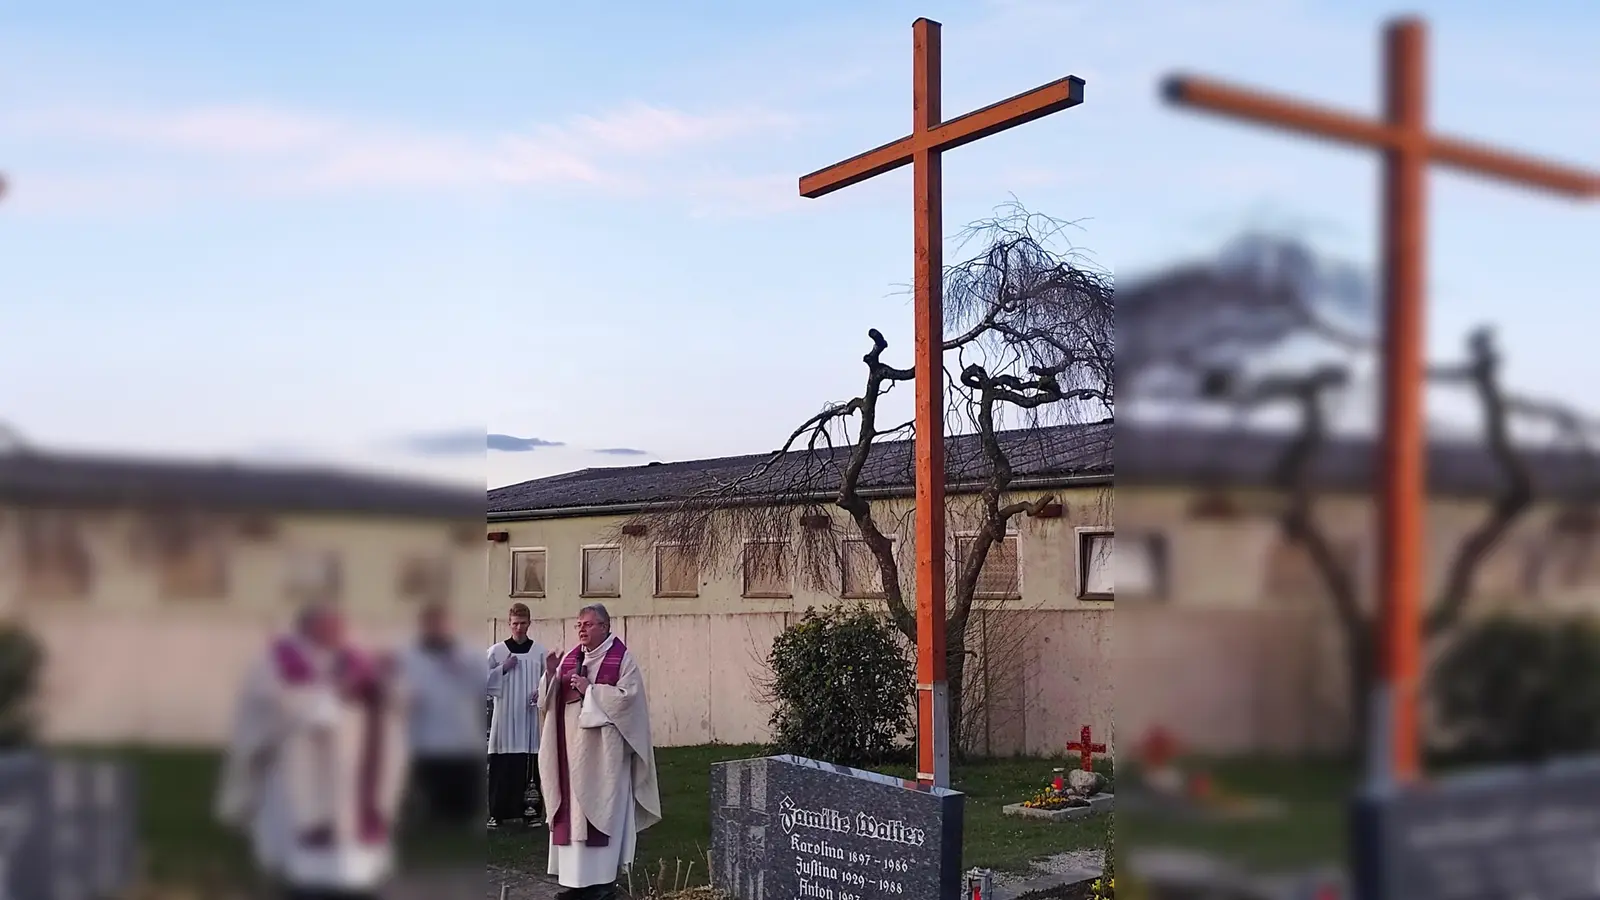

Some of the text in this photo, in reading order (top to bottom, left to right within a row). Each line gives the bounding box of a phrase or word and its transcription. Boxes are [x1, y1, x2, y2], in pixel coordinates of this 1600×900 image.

[779, 795, 925, 846] Familie Walter
[790, 833, 844, 860] Karolina
[849, 852, 871, 866] 1897
[884, 859, 908, 873] 1986
[799, 878, 833, 900] Anton
[842, 871, 865, 889] 1929
[879, 879, 903, 894] 1988
